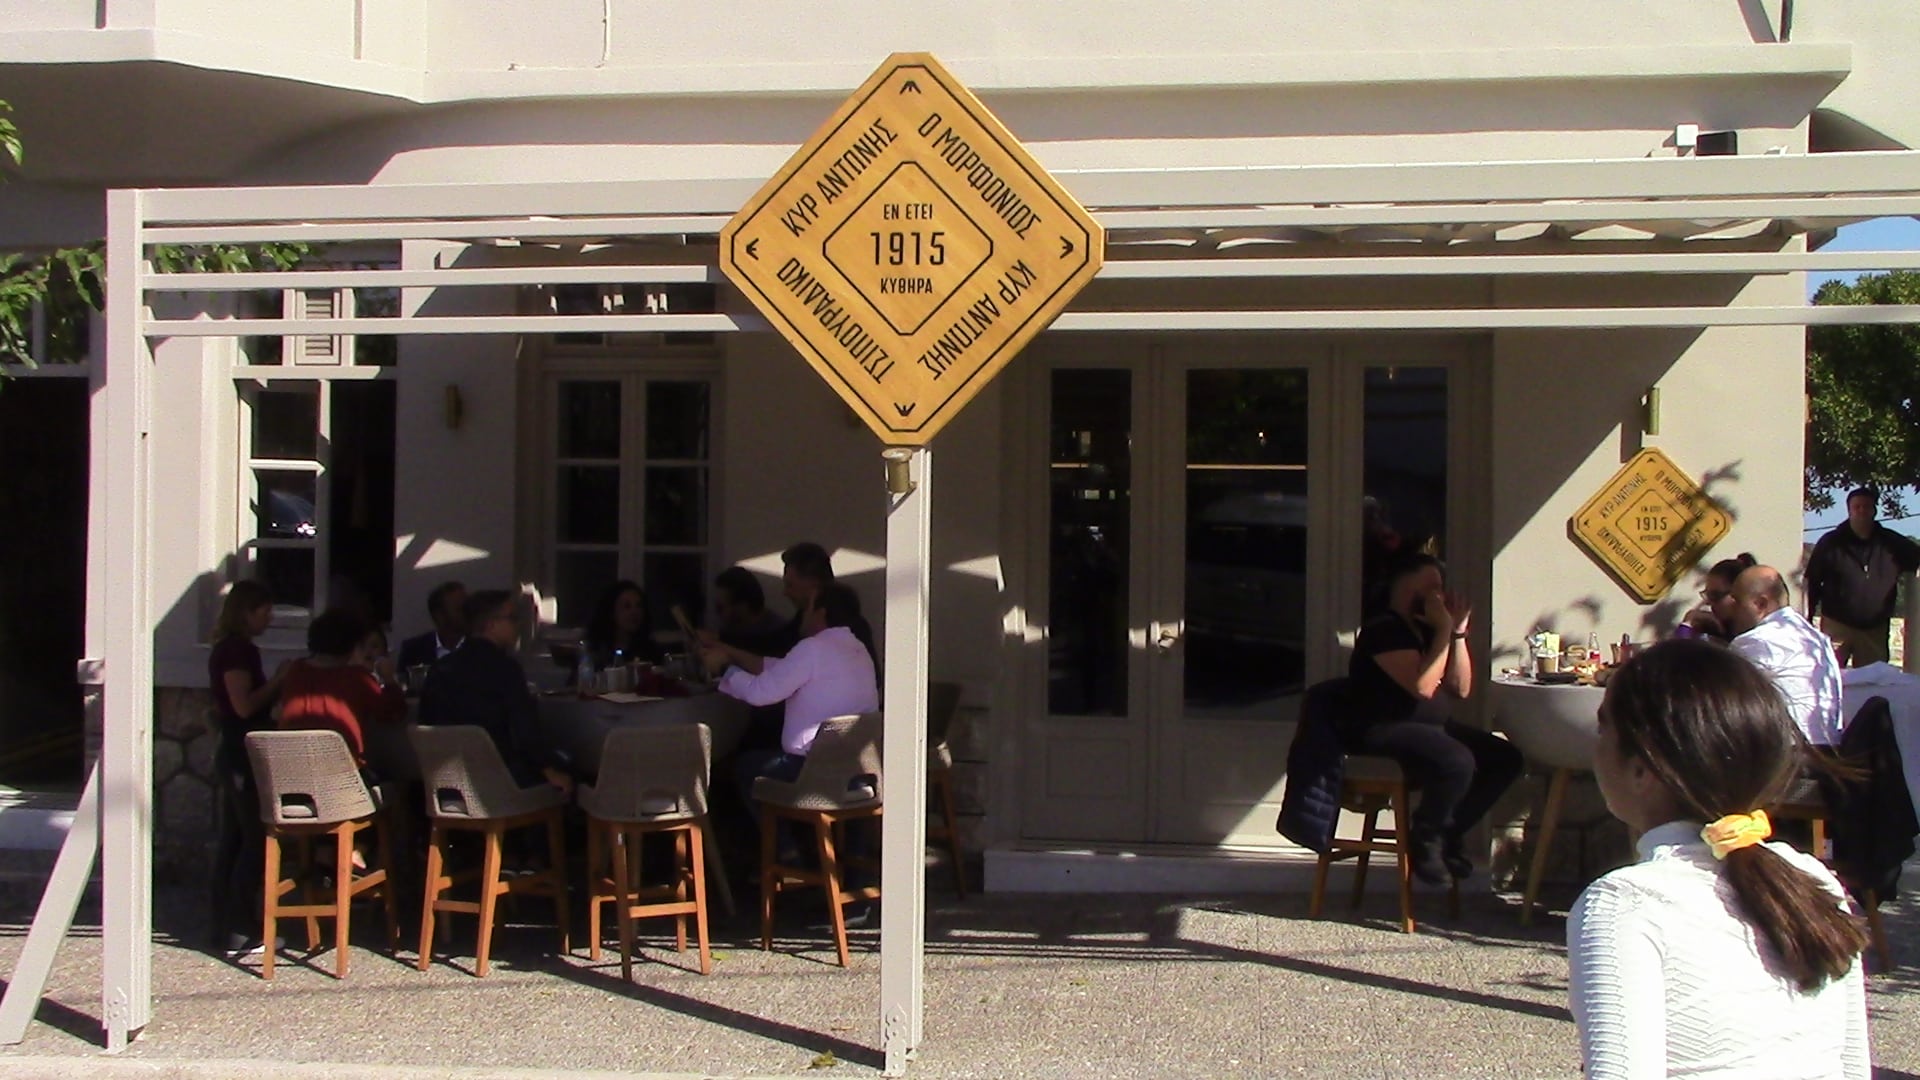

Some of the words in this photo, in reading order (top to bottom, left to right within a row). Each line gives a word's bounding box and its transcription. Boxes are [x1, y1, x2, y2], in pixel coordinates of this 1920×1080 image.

[781, 193, 818, 238] ΚΥΡ
[815, 117, 899, 206] ΑΝΤΩΝΗΣ
[917, 112, 943, 138] Ο
[931, 126, 1042, 240] ΜΟΡΦΟΝΙΟΣ
[883, 203, 900, 220] ΕΝ
[905, 203, 933, 220] ΕΤΕΙ
[870, 231, 945, 266] 1915
[880, 277, 933, 294] ΚΥΘΗΡΑ
[998, 258, 1038, 306] ΚΥΡ
[776, 256, 896, 385] ΤΣΙΠΟΥΡΑΔΙΚΟ
[916, 292, 1001, 381] ΑΝΤΩΝΗΣ
[1635, 516, 1668, 531] 1915
